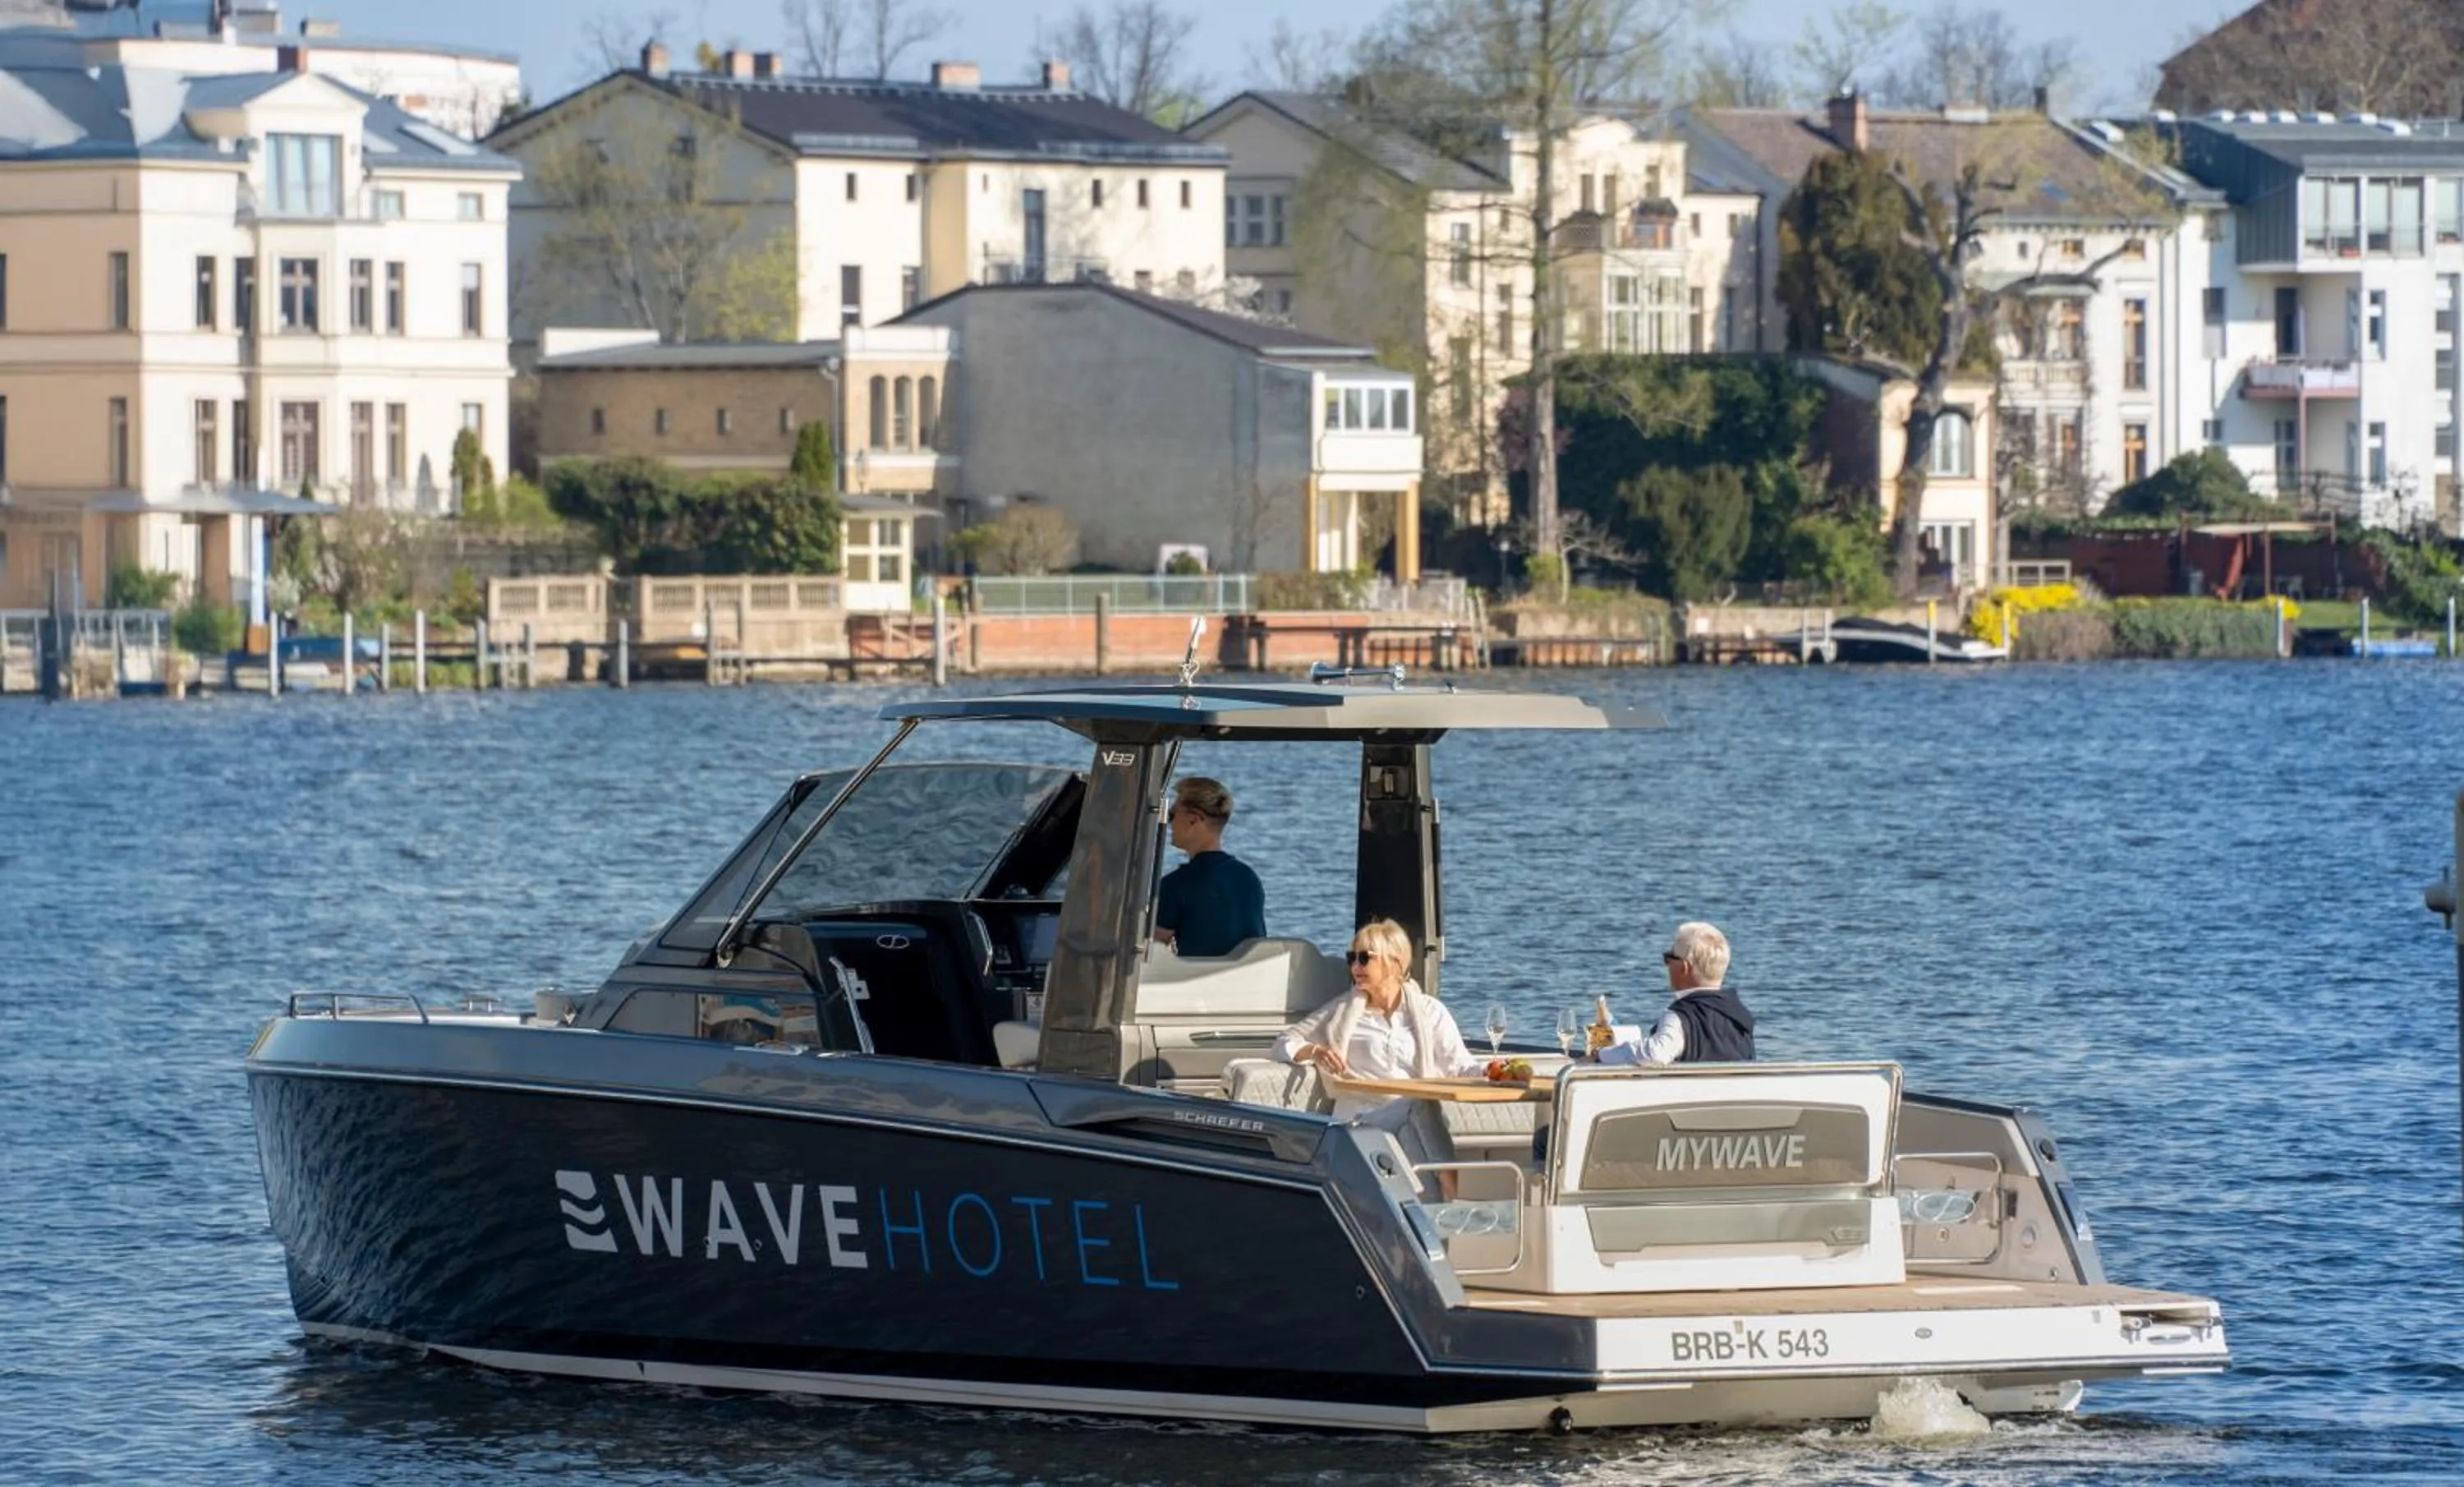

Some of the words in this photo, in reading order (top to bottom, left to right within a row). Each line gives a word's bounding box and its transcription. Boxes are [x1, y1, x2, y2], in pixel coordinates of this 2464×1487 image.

[1101, 750, 1135, 766] V33
[1173, 1111, 1264, 1131] SCHAEFER
[1656, 1135, 1806, 1171] MYWAVE
[1671, 1329, 1768, 1360] BRB-K
[1778, 1328, 1829, 1358] 543
